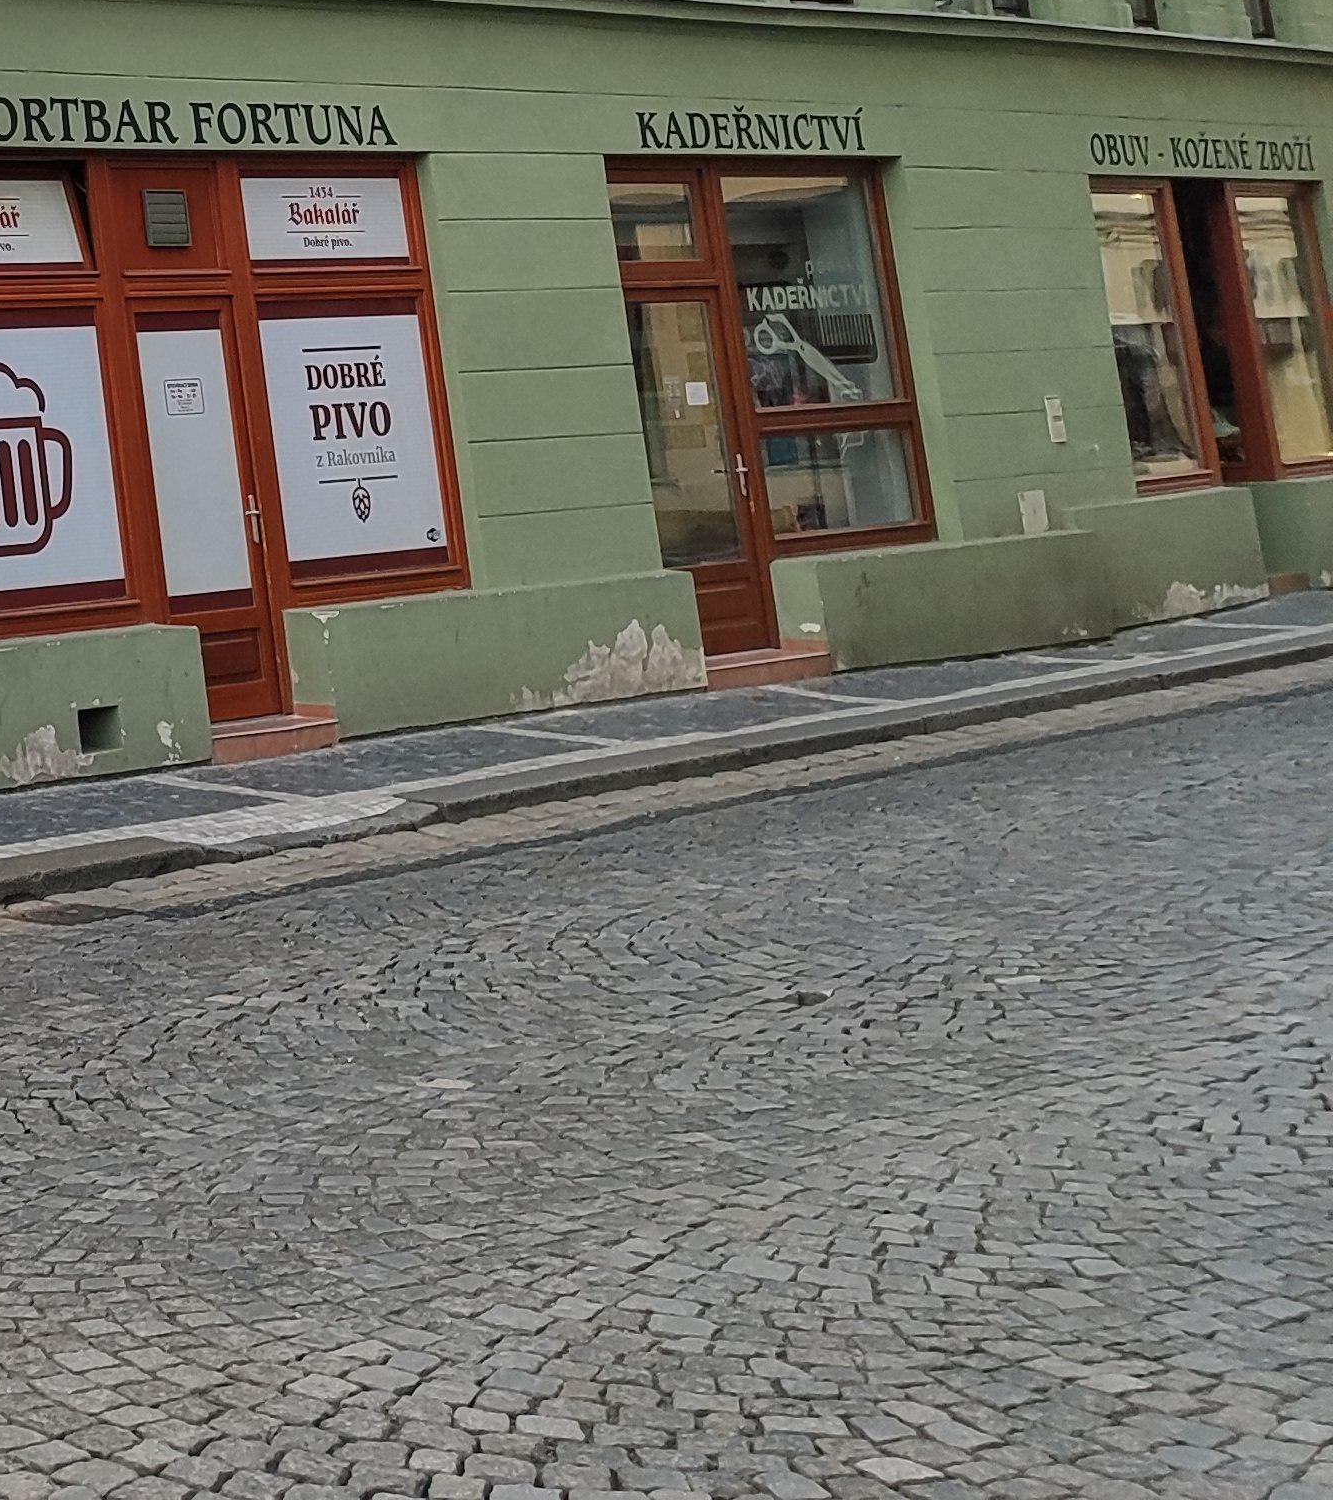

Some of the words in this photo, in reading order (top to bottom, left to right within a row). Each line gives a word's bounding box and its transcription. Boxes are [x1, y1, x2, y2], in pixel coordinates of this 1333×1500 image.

[189, 102, 398, 146] FORTUNA
[635, 105, 866, 151] KADEŘNICTVÍ
[1090, 133, 1149, 166] OBUV
[1169, 132, 1252, 170] KOŽENÉ
[1256, 135, 1316, 171] ZBOŽÍ
[309, 186, 334, 199] 1454
[288, 202, 360, 226] Bakalář
[303, 235, 330, 248] Dobré
[331, 235, 354, 250] pivo.
[304, 354, 387, 390] DOBRÉ
[309, 401, 392, 441] PIVO
[316, 455, 324, 468] z
[326, 445, 396, 467] Rakovníka
